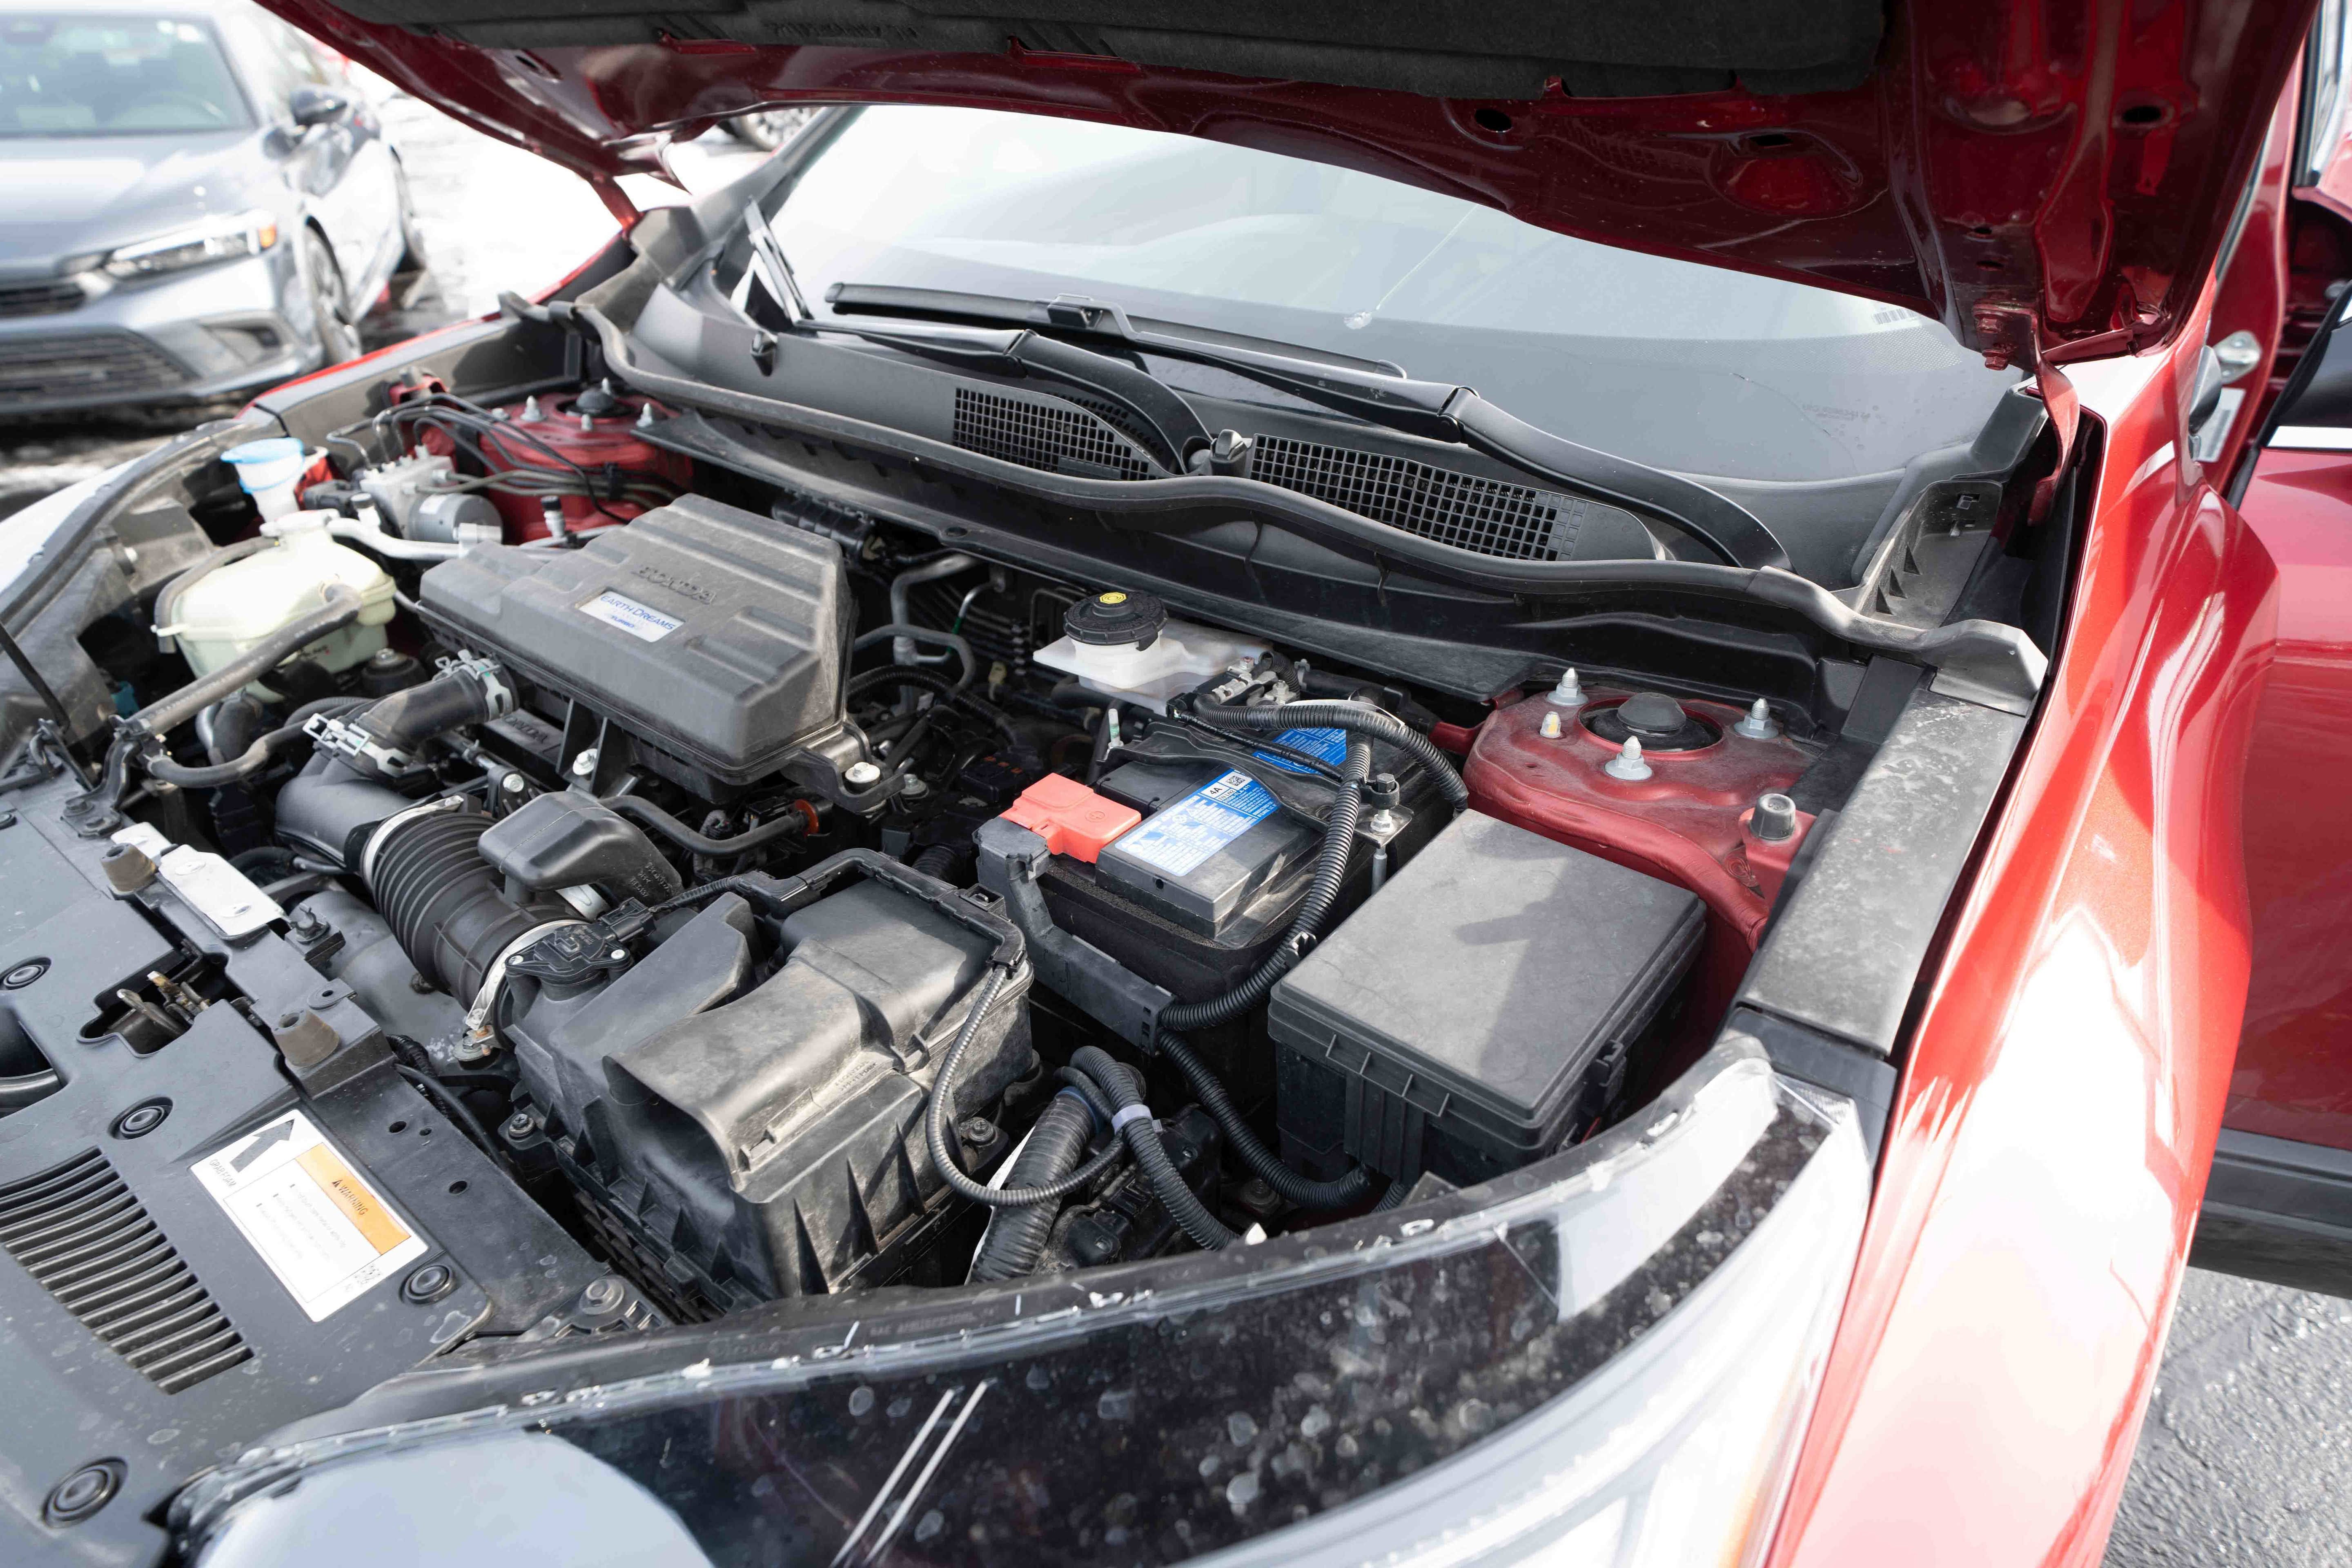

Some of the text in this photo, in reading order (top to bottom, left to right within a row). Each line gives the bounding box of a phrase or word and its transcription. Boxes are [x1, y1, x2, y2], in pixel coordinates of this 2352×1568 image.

[600, 595, 634, 612] EARTH
[633, 608, 676, 630] DREAMS
[611, 615, 635, 628] TURBO
[1210, 787, 1223, 795] 4A
[1225, 789, 1235, 797] LN2
[339, 1185, 369, 1216] WARNING
